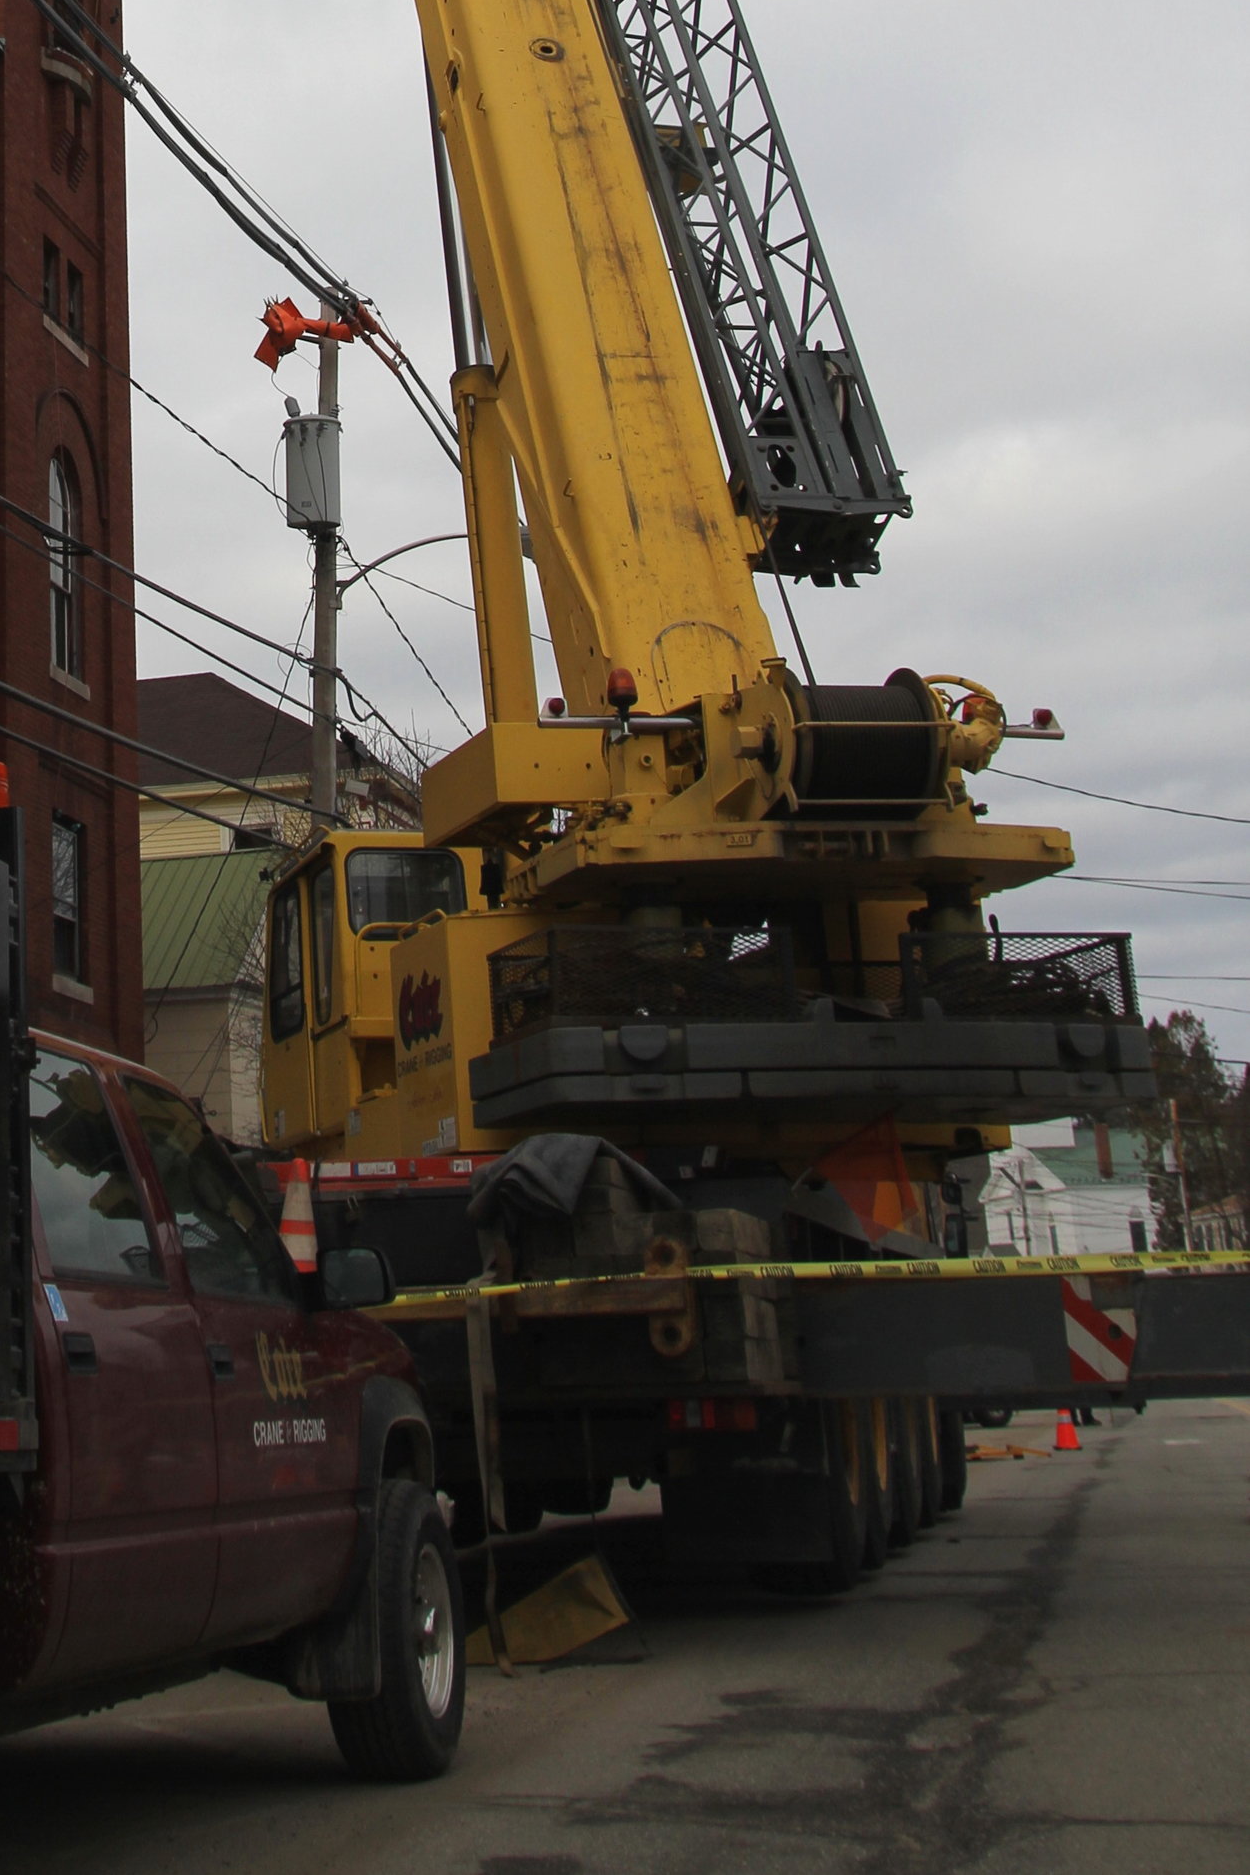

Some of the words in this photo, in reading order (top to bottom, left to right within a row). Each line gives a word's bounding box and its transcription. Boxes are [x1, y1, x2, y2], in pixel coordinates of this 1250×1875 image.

[829, 1264, 864, 1278] CAUTION
[906, 1261, 941, 1276] CAUTION
[973, 1259, 1007, 1274] CAUTION
[1046, 1257, 1081, 1271] CAUTION
[760, 1265, 795, 1278] CAUTION
[253, 1420, 285, 1447] CRANE
[293, 1418, 327, 1444] RIGGING
